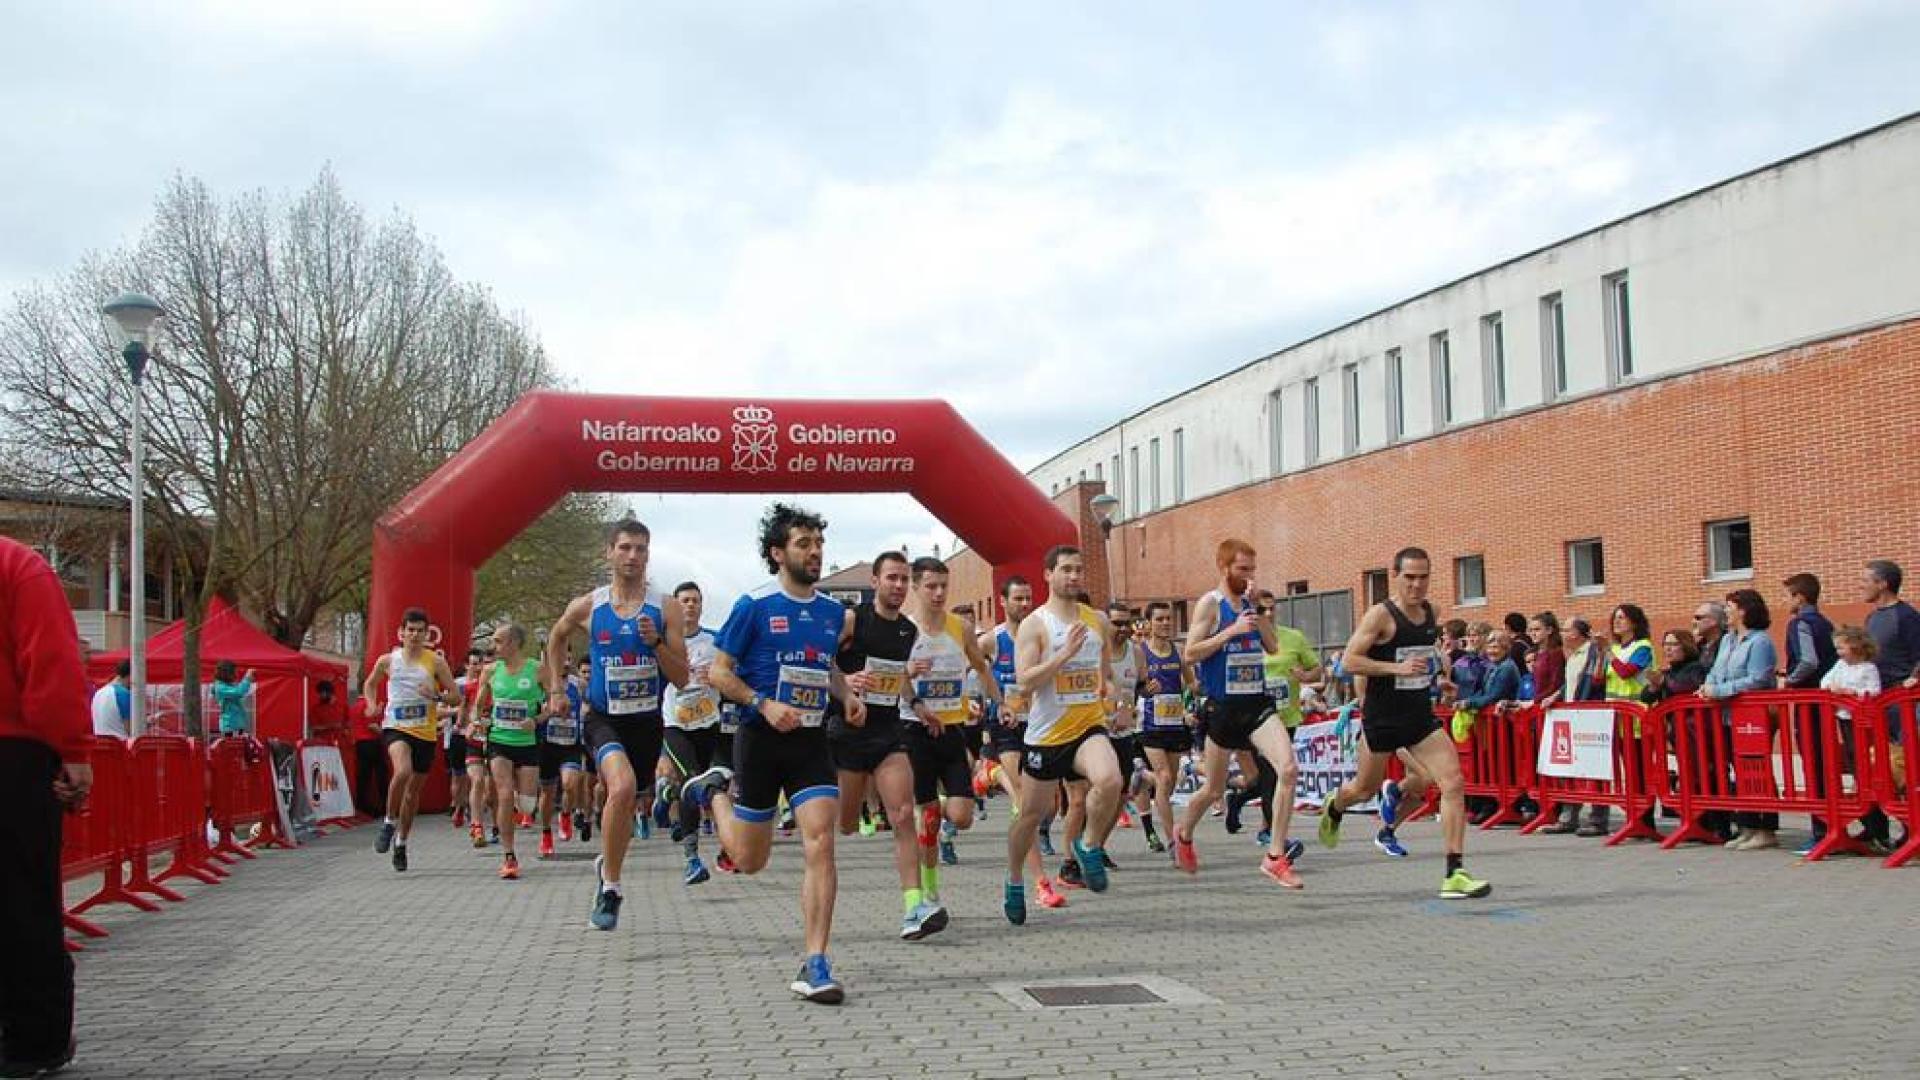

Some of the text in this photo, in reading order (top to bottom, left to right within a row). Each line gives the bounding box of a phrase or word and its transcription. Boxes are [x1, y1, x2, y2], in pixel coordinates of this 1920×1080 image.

[582, 420, 721, 443] Nafarroako
[788, 423, 896, 444] Gobierno
[598, 450, 720, 472] Gobernua
[788, 452, 915, 473] de Navarra
[620, 681, 650, 698] 522
